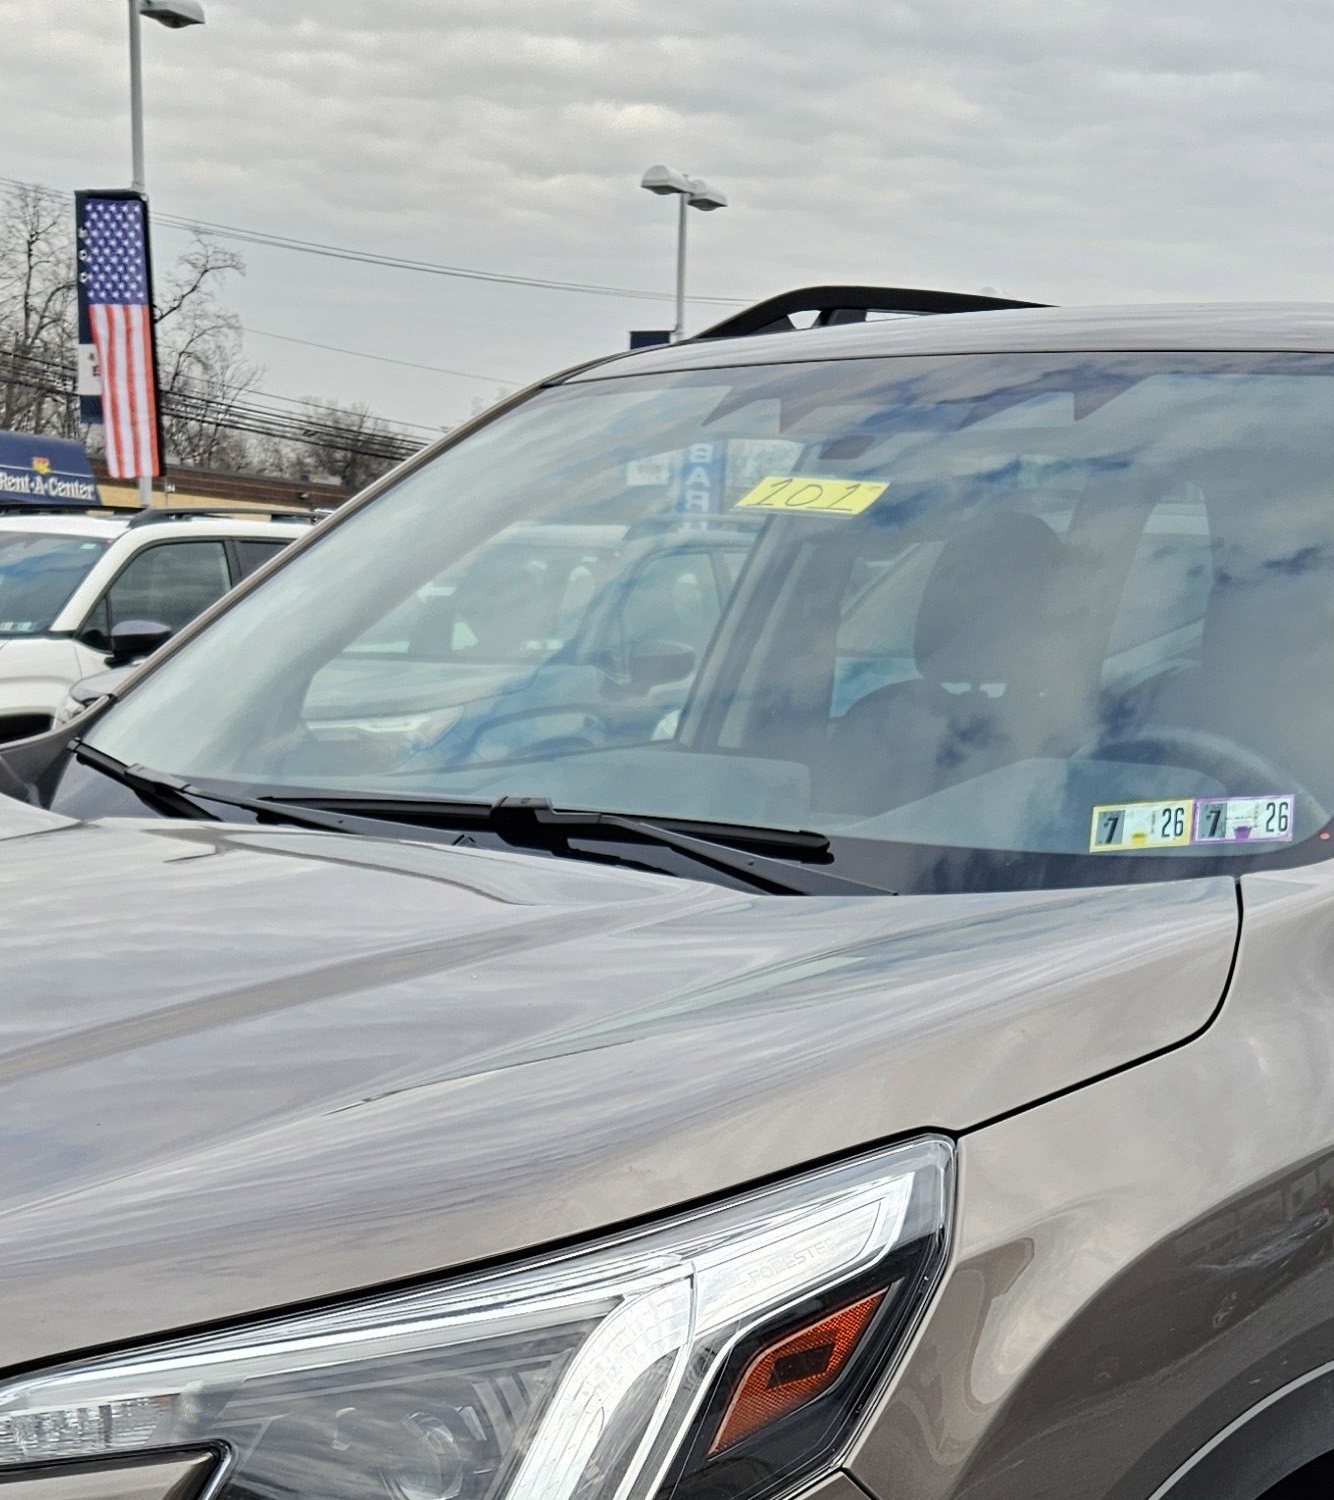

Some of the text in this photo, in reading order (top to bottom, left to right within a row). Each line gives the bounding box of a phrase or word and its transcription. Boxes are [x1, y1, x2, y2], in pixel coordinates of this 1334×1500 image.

[745, 478, 862, 512] 101
[1104, 816, 1119, 844] 7
[1160, 807, 1185, 838] 26
[1206, 809, 1221, 838] 7
[1265, 801, 1289, 833] 26
